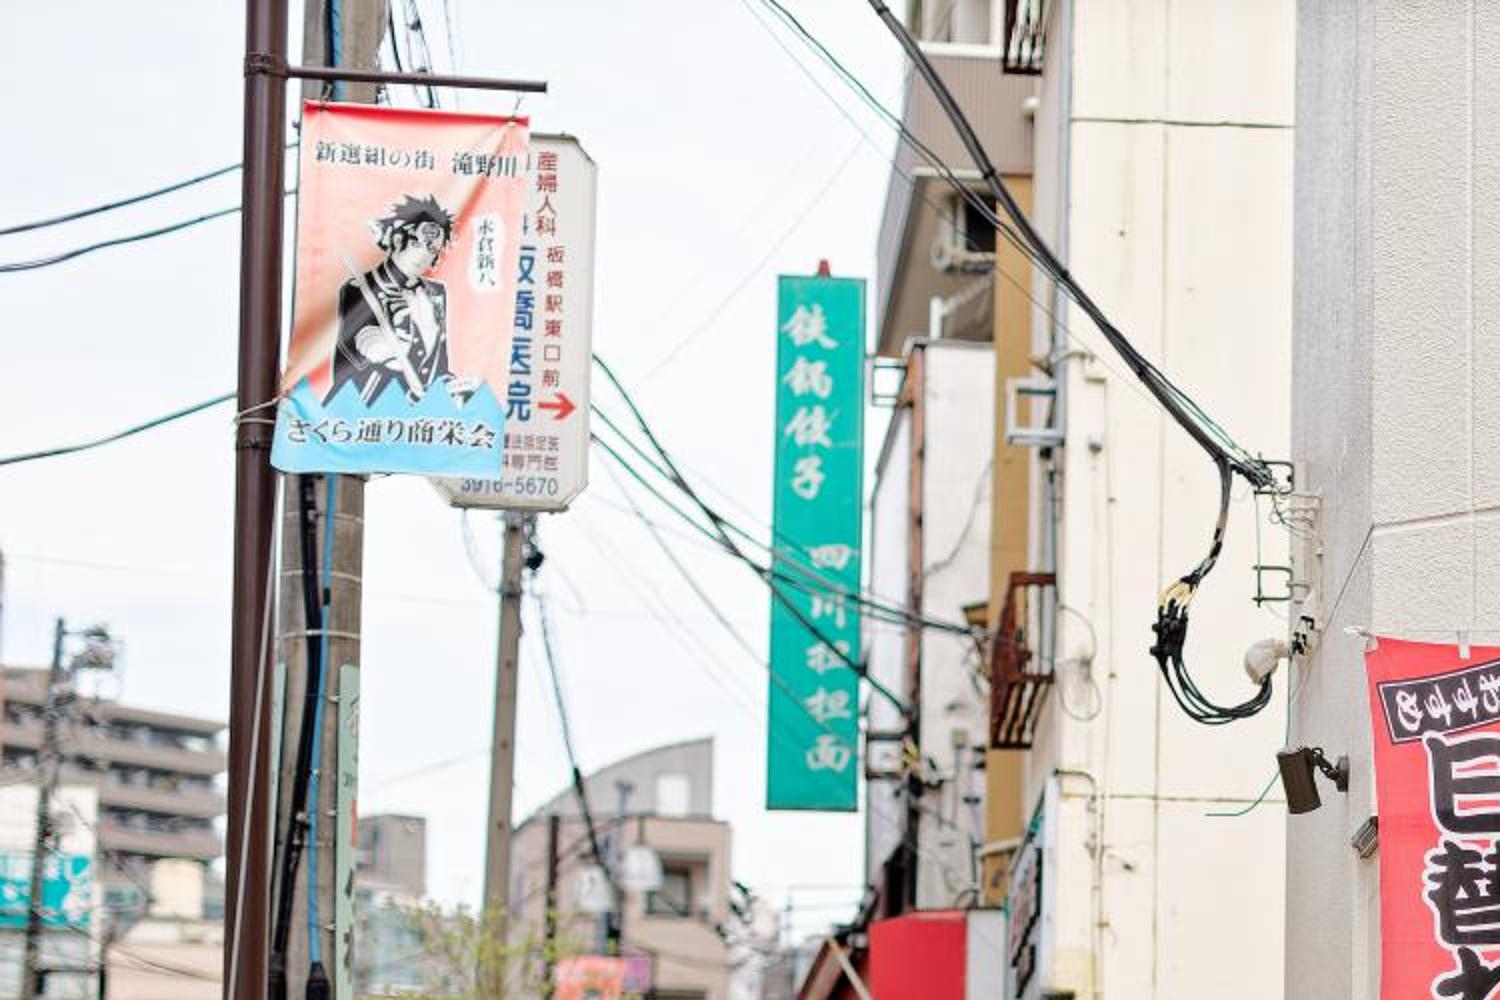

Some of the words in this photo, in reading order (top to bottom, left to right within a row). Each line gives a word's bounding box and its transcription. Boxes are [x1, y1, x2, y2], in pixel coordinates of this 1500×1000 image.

[316, 141, 434, 170] 新選組の街
[452, 152, 517, 178] 滝野川
[536, 151, 559, 237] 産婦人科
[542, 245, 566, 388] 板橋駅東口前
[287, 418, 497, 449] さくら通り商栄会
